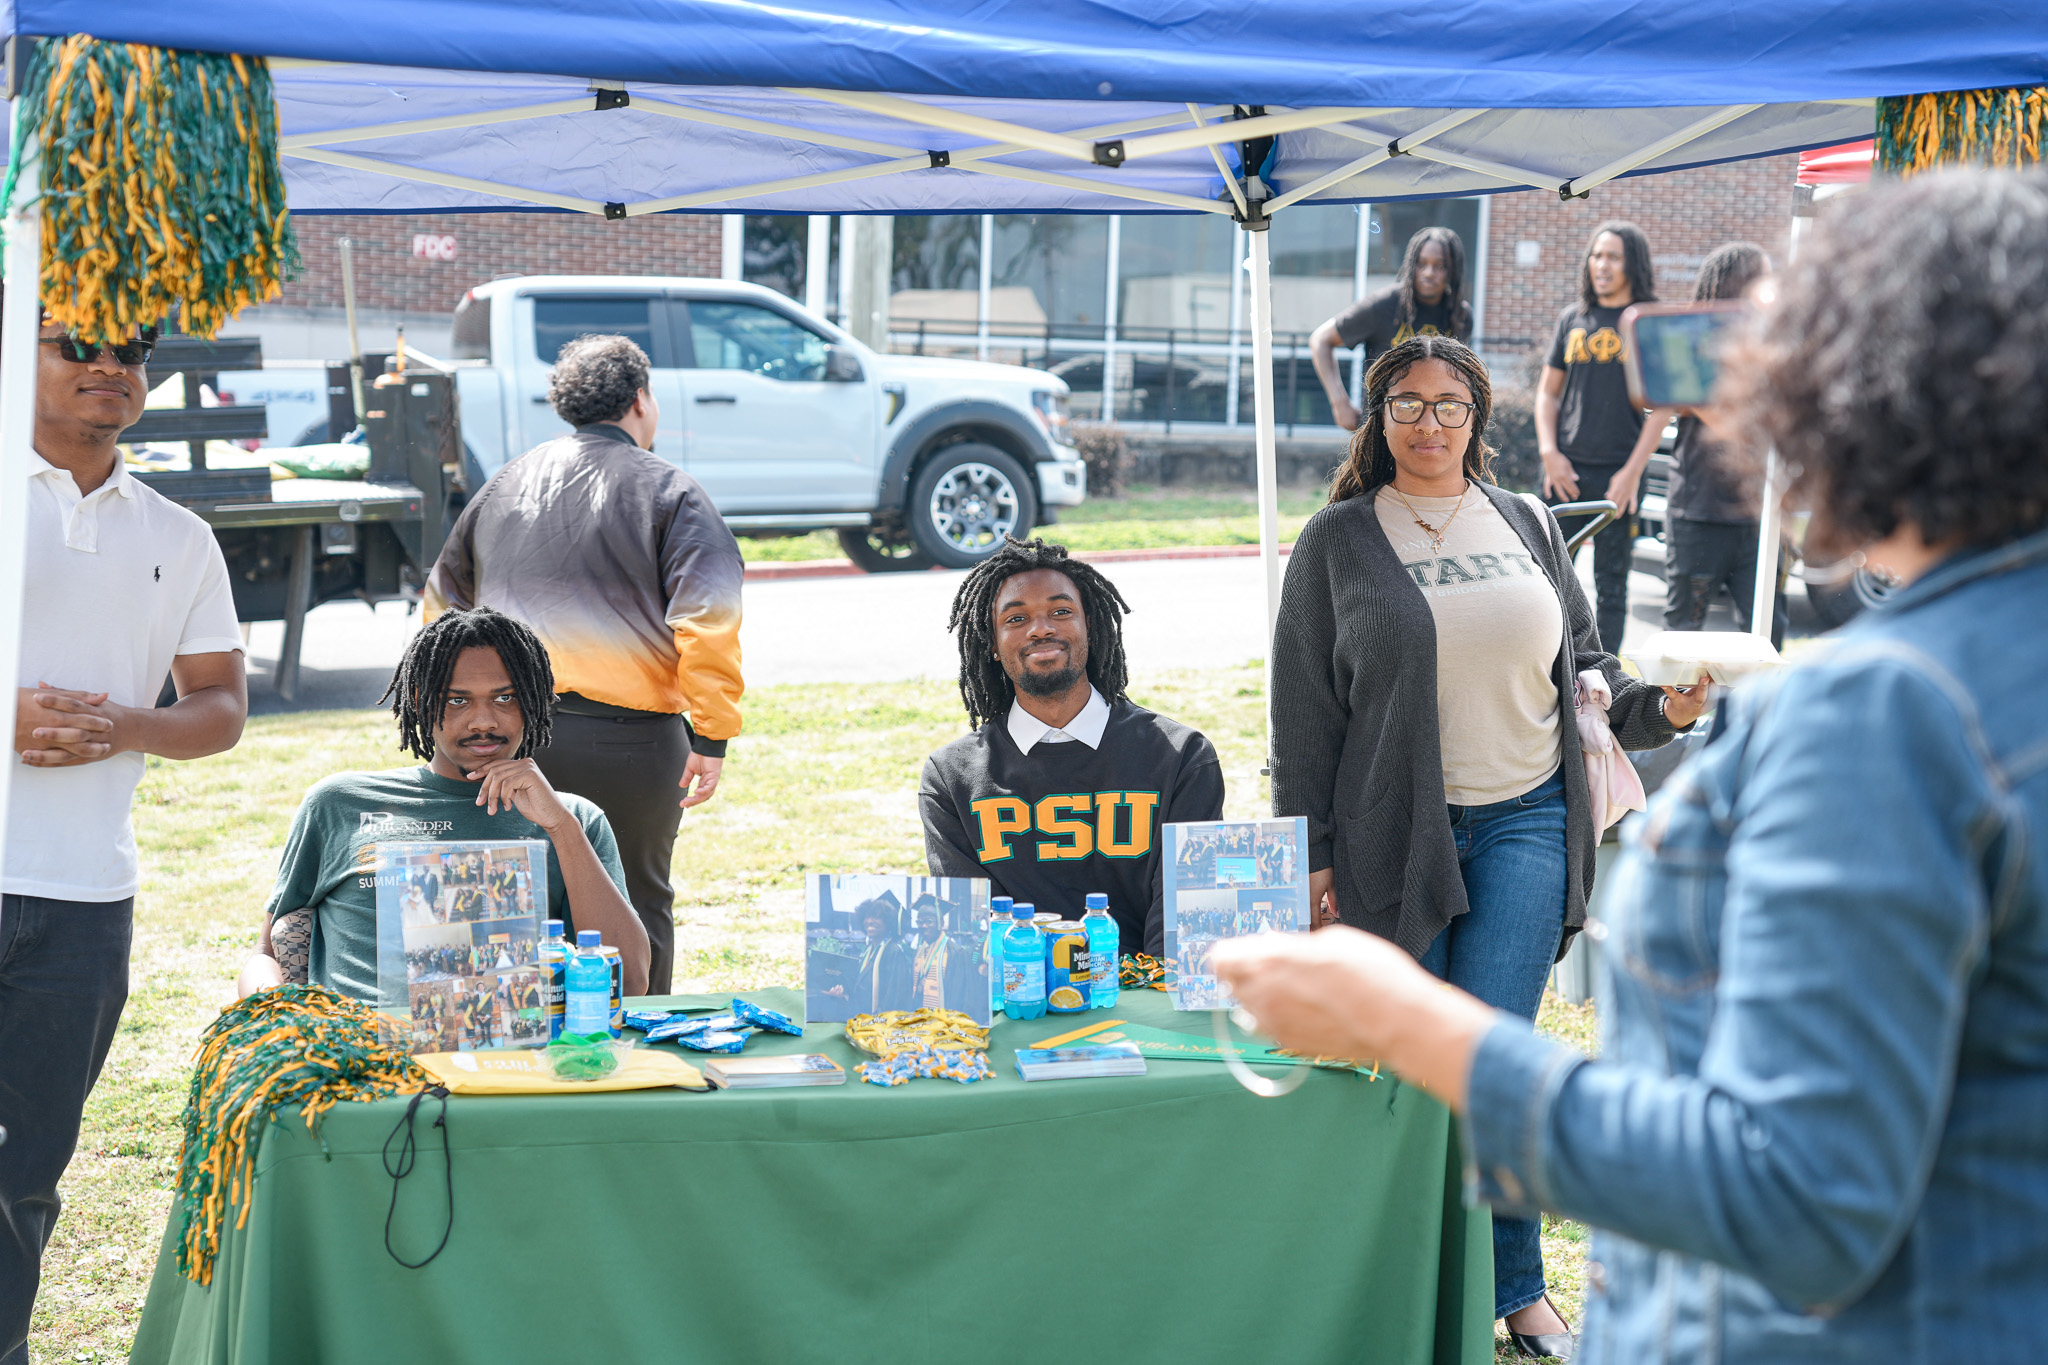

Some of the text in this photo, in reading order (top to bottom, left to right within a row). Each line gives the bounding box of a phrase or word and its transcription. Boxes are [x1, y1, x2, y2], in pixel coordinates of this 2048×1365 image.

[413, 234, 456, 260] FDC
[1403, 552, 1534, 587] TART
[1437, 583, 1489, 597] BRIDGE
[969, 790, 1161, 865] PSU
